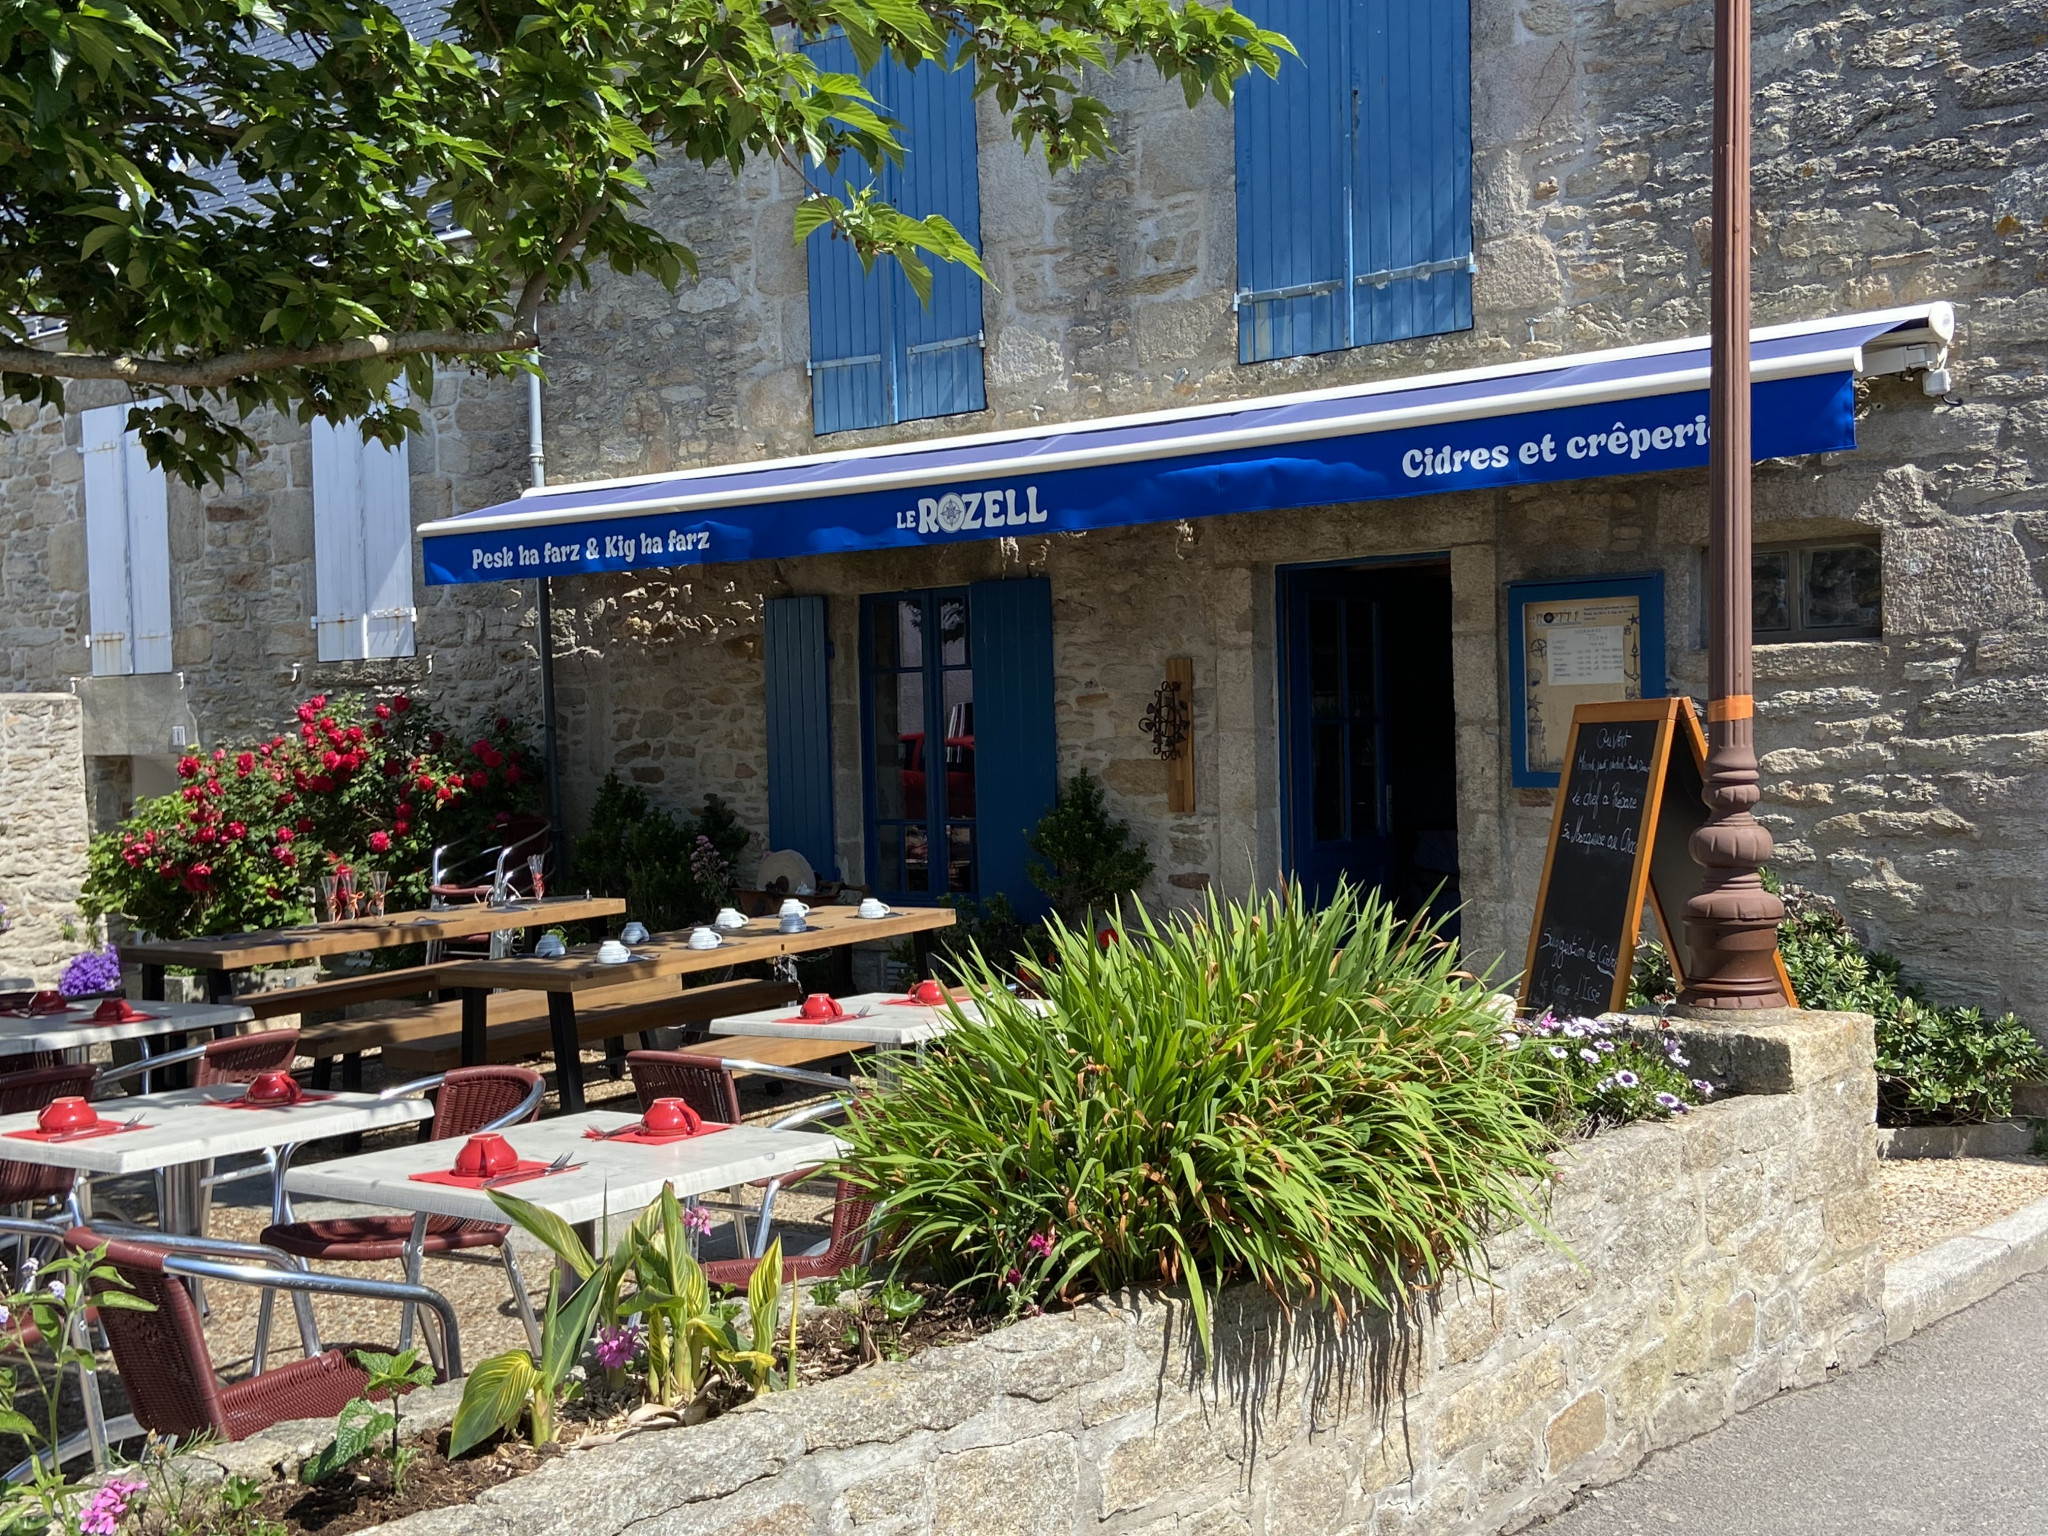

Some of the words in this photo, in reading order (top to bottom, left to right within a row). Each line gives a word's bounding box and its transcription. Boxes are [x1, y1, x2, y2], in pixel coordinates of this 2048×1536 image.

[1402, 445, 1509, 478] Cidres
[1518, 433, 1557, 465] et
[896, 511, 916, 529] LE
[917, 486, 1048, 534] ROZELL
[472, 547, 514, 570] Pesk
[519, 544, 540, 566] ha
[544, 542, 580, 565] farz
[585, 537, 600, 559] &
[605, 535, 635, 563] Kig
[640, 532, 663, 555] ha
[668, 529, 710, 552] farz
[1587, 938, 1596, 962] de
